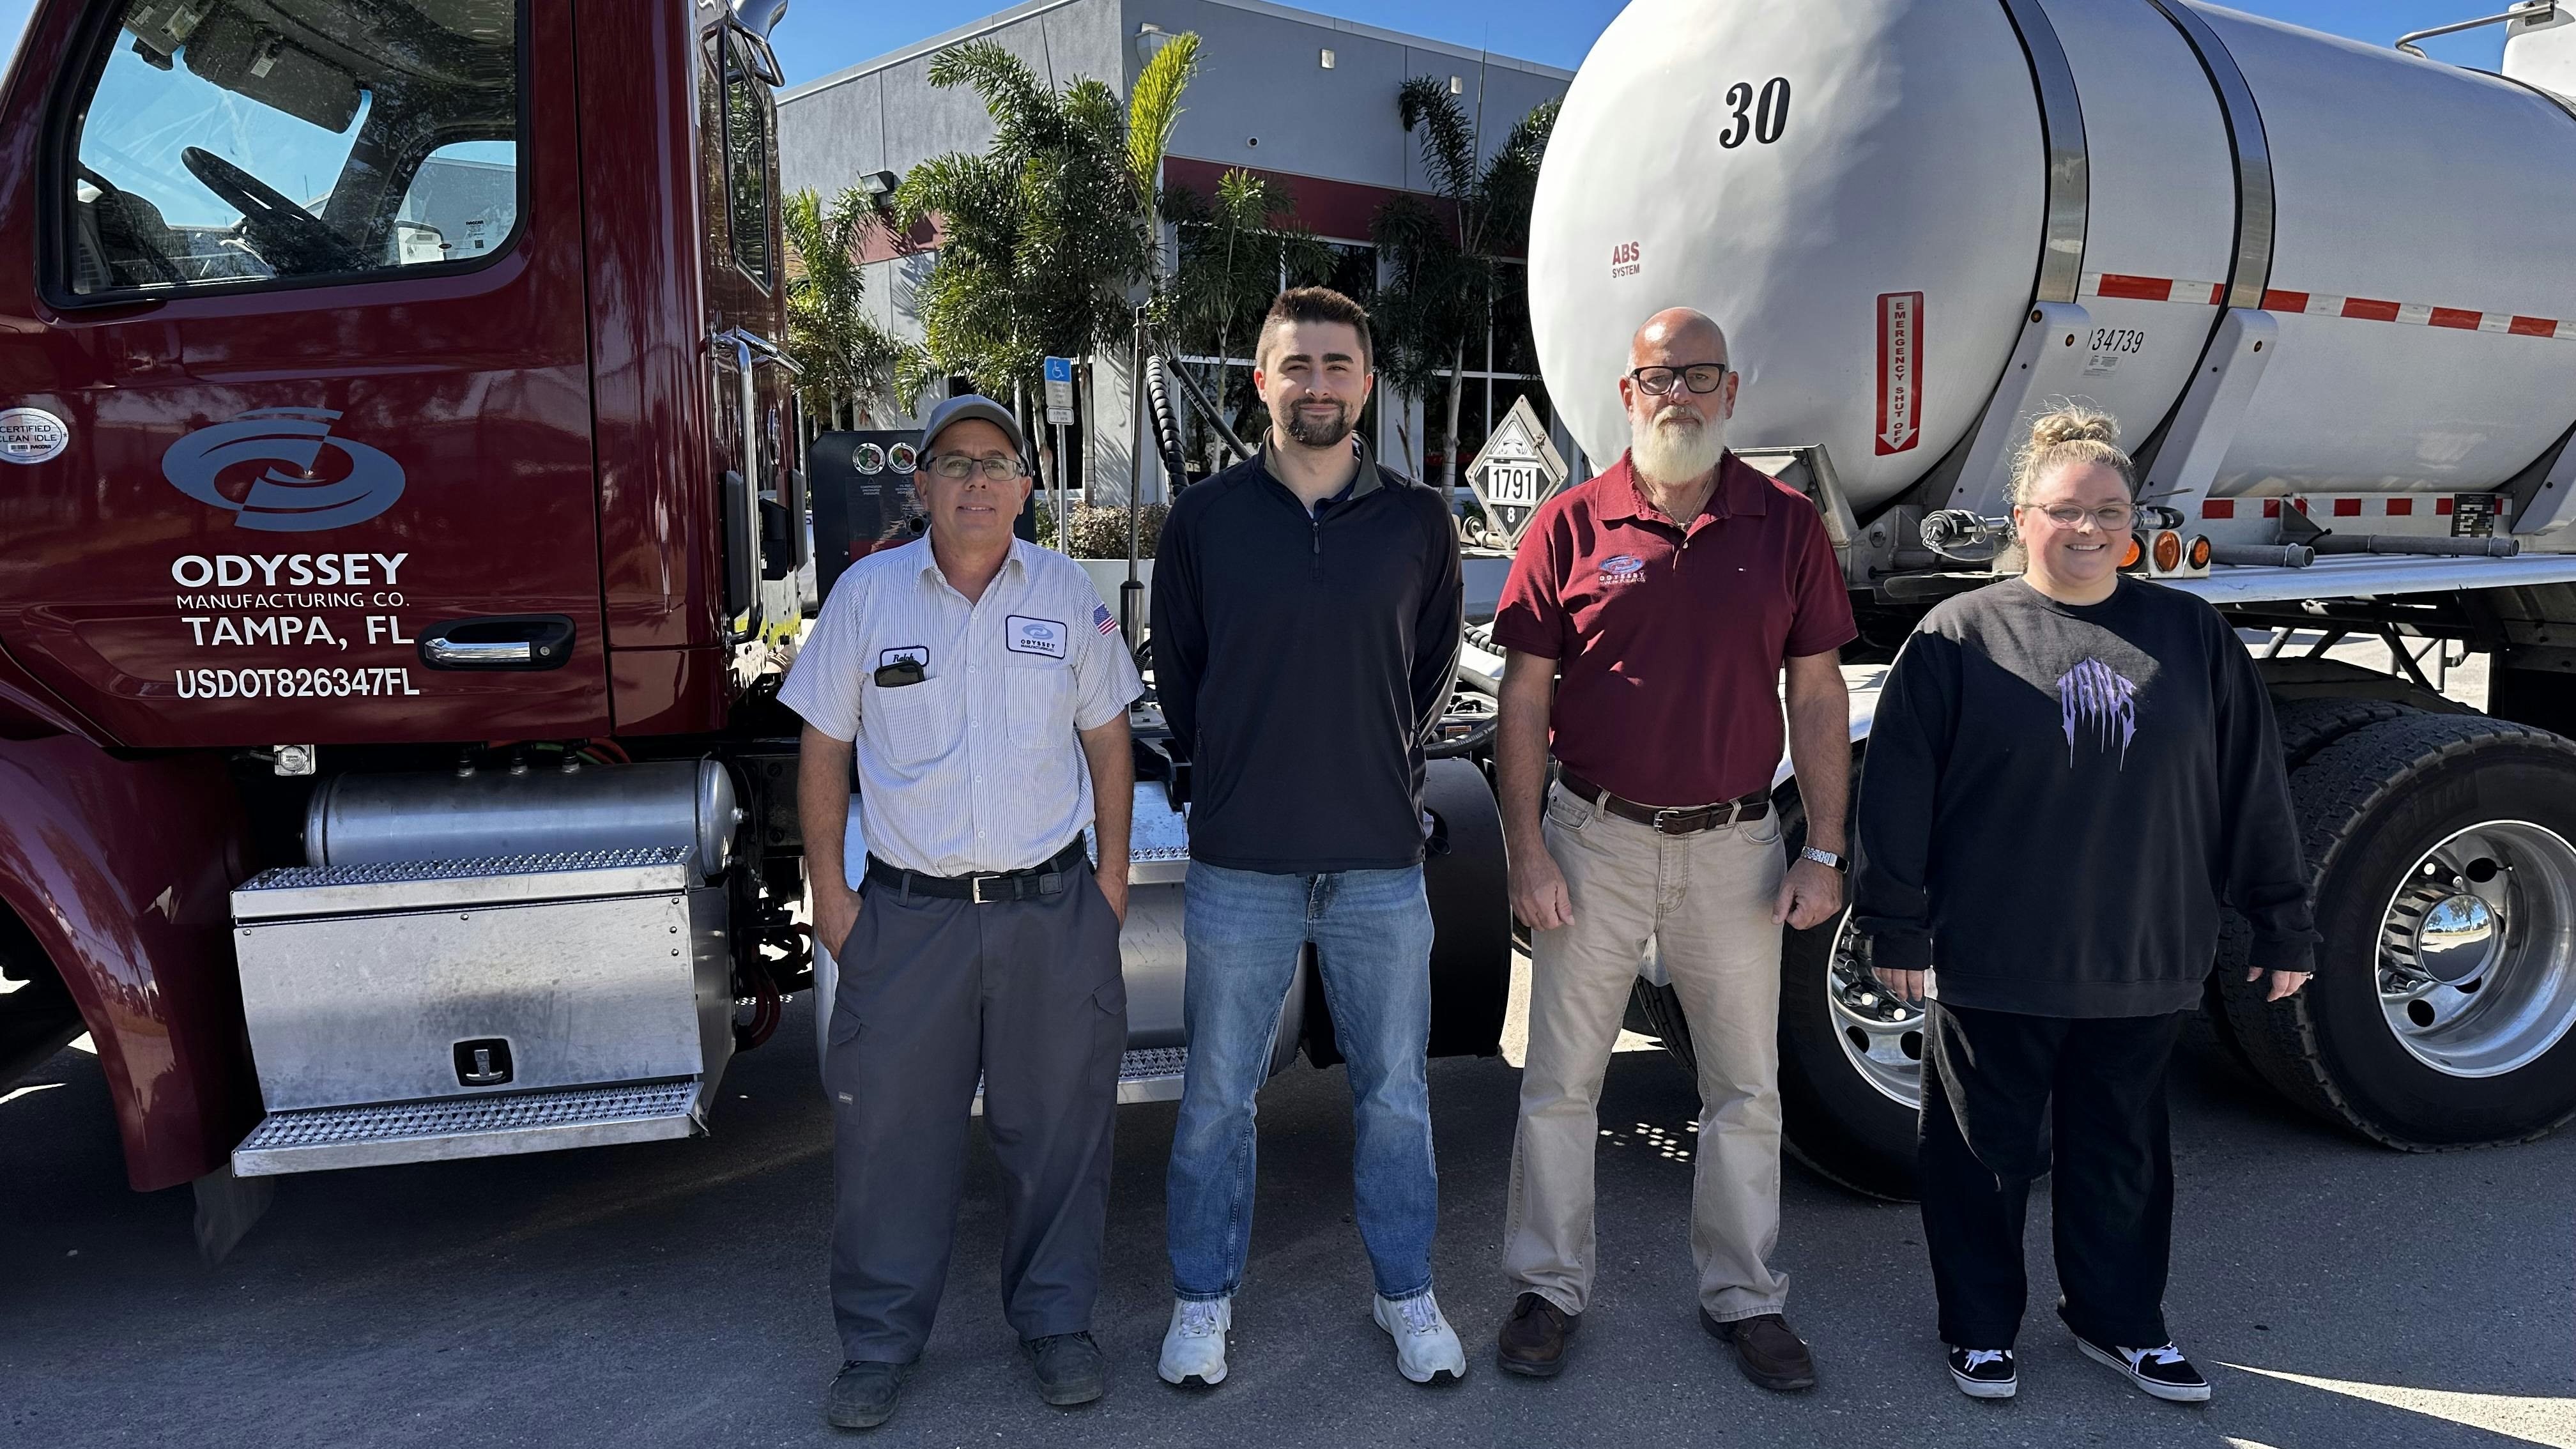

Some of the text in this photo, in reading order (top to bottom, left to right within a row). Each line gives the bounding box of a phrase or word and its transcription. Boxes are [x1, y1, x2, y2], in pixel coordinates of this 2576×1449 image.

[1719, 76, 1791, 150] 30
[1612, 241, 1640, 266] ABS
[1612, 263, 1640, 279] SYSTEM
[1893, 302, 1906, 443] EMERGENCY SHUT OFF
[0, 425, 51, 433] CERTIFIED
[1493, 468, 1531, 500] 1791
[1506, 506, 1515, 523] 8
[171, 553, 409, 588] ODYSSEY
[176, 592, 410, 610] MANUFACTURING CO.
[181, 615, 415, 651] TAMPA, FL
[1020, 639, 1055, 649] ODYSSEY
[174, 667, 420, 699] USDOT826347FL
